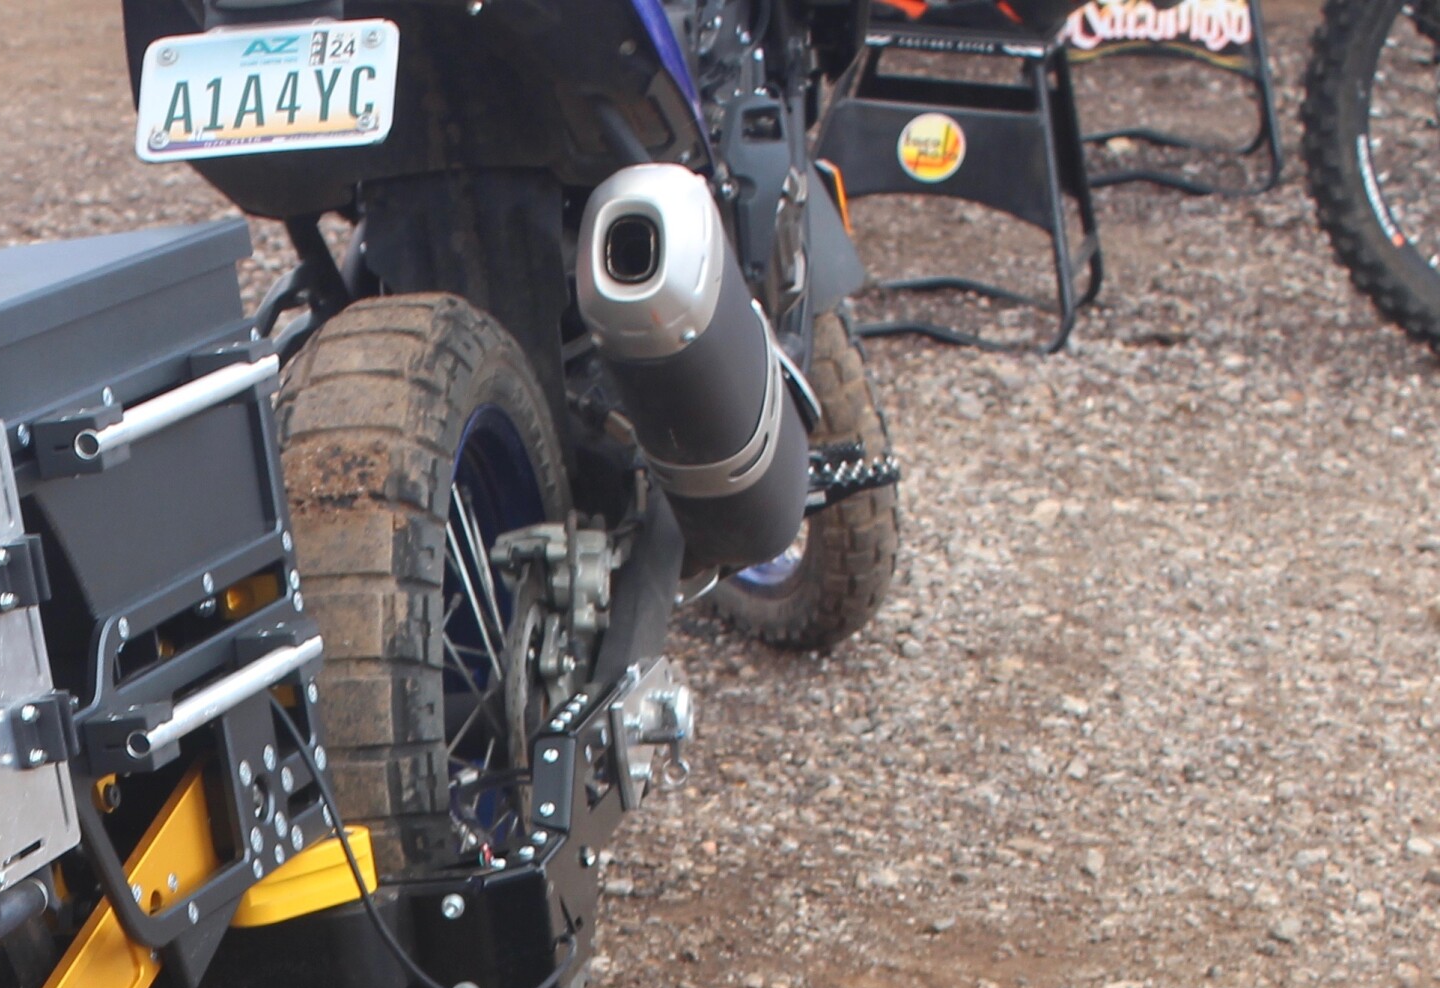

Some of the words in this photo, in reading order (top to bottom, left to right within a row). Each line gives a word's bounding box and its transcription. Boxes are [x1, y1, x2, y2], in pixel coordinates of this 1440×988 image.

[242, 35, 300, 56] AZ
[330, 38, 356, 58] 24
[163, 65, 376, 135] A1A4YC
